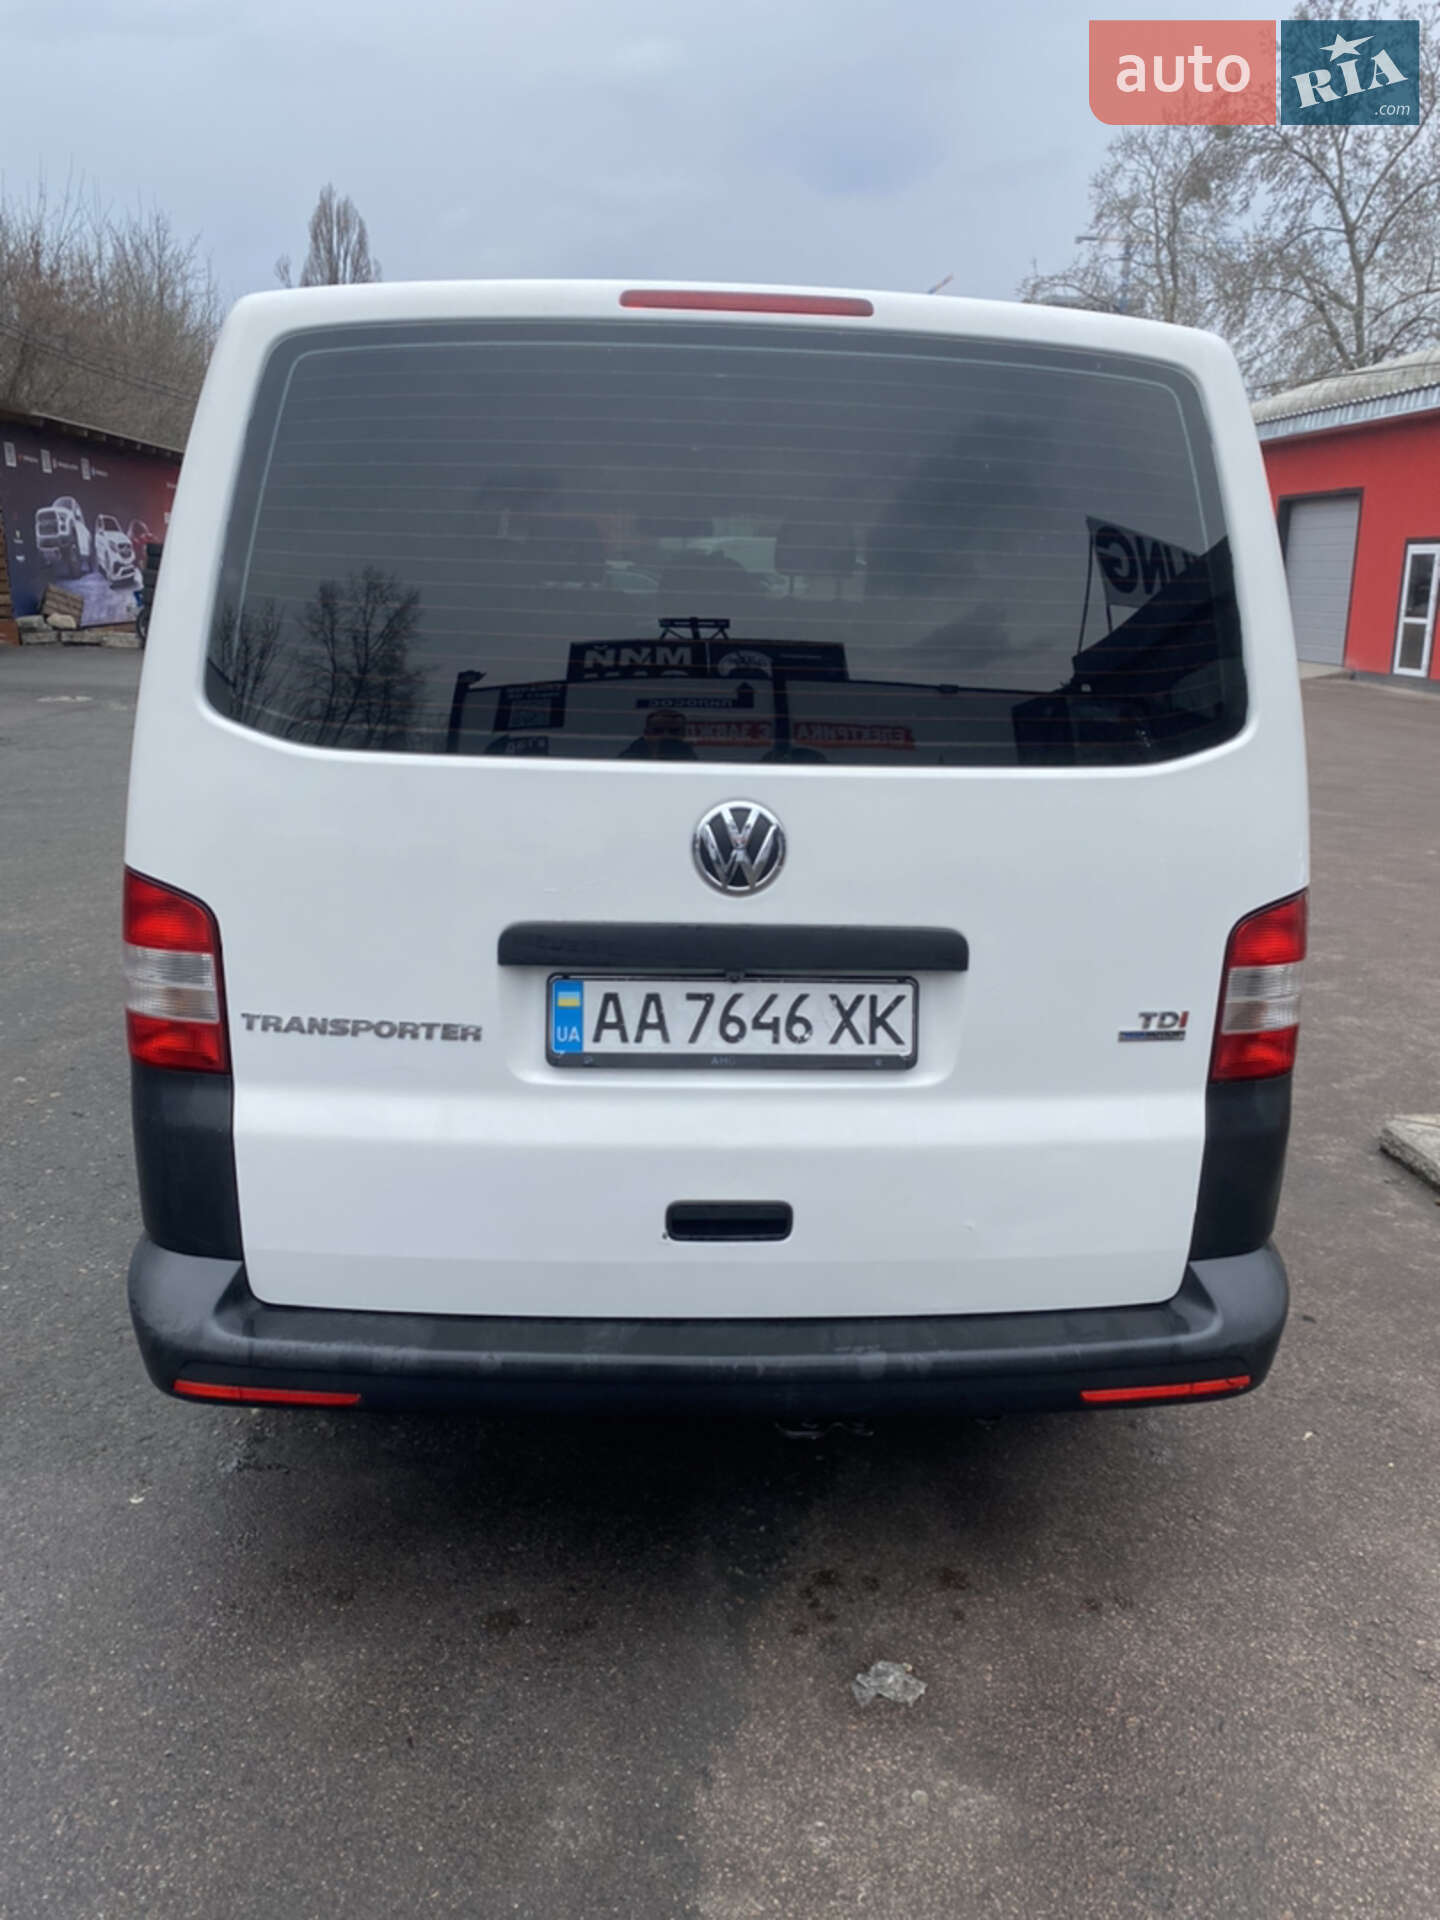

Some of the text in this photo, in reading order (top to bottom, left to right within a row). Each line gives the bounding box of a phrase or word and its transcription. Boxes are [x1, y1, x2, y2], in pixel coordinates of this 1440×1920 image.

[241, 1013, 483, 1042] TRANSPORTER
[592, 992, 907, 1046] AA 7646 XK
[1138, 1010, 1190, 1030] TDI
[556, 1024, 581, 1044] UA
